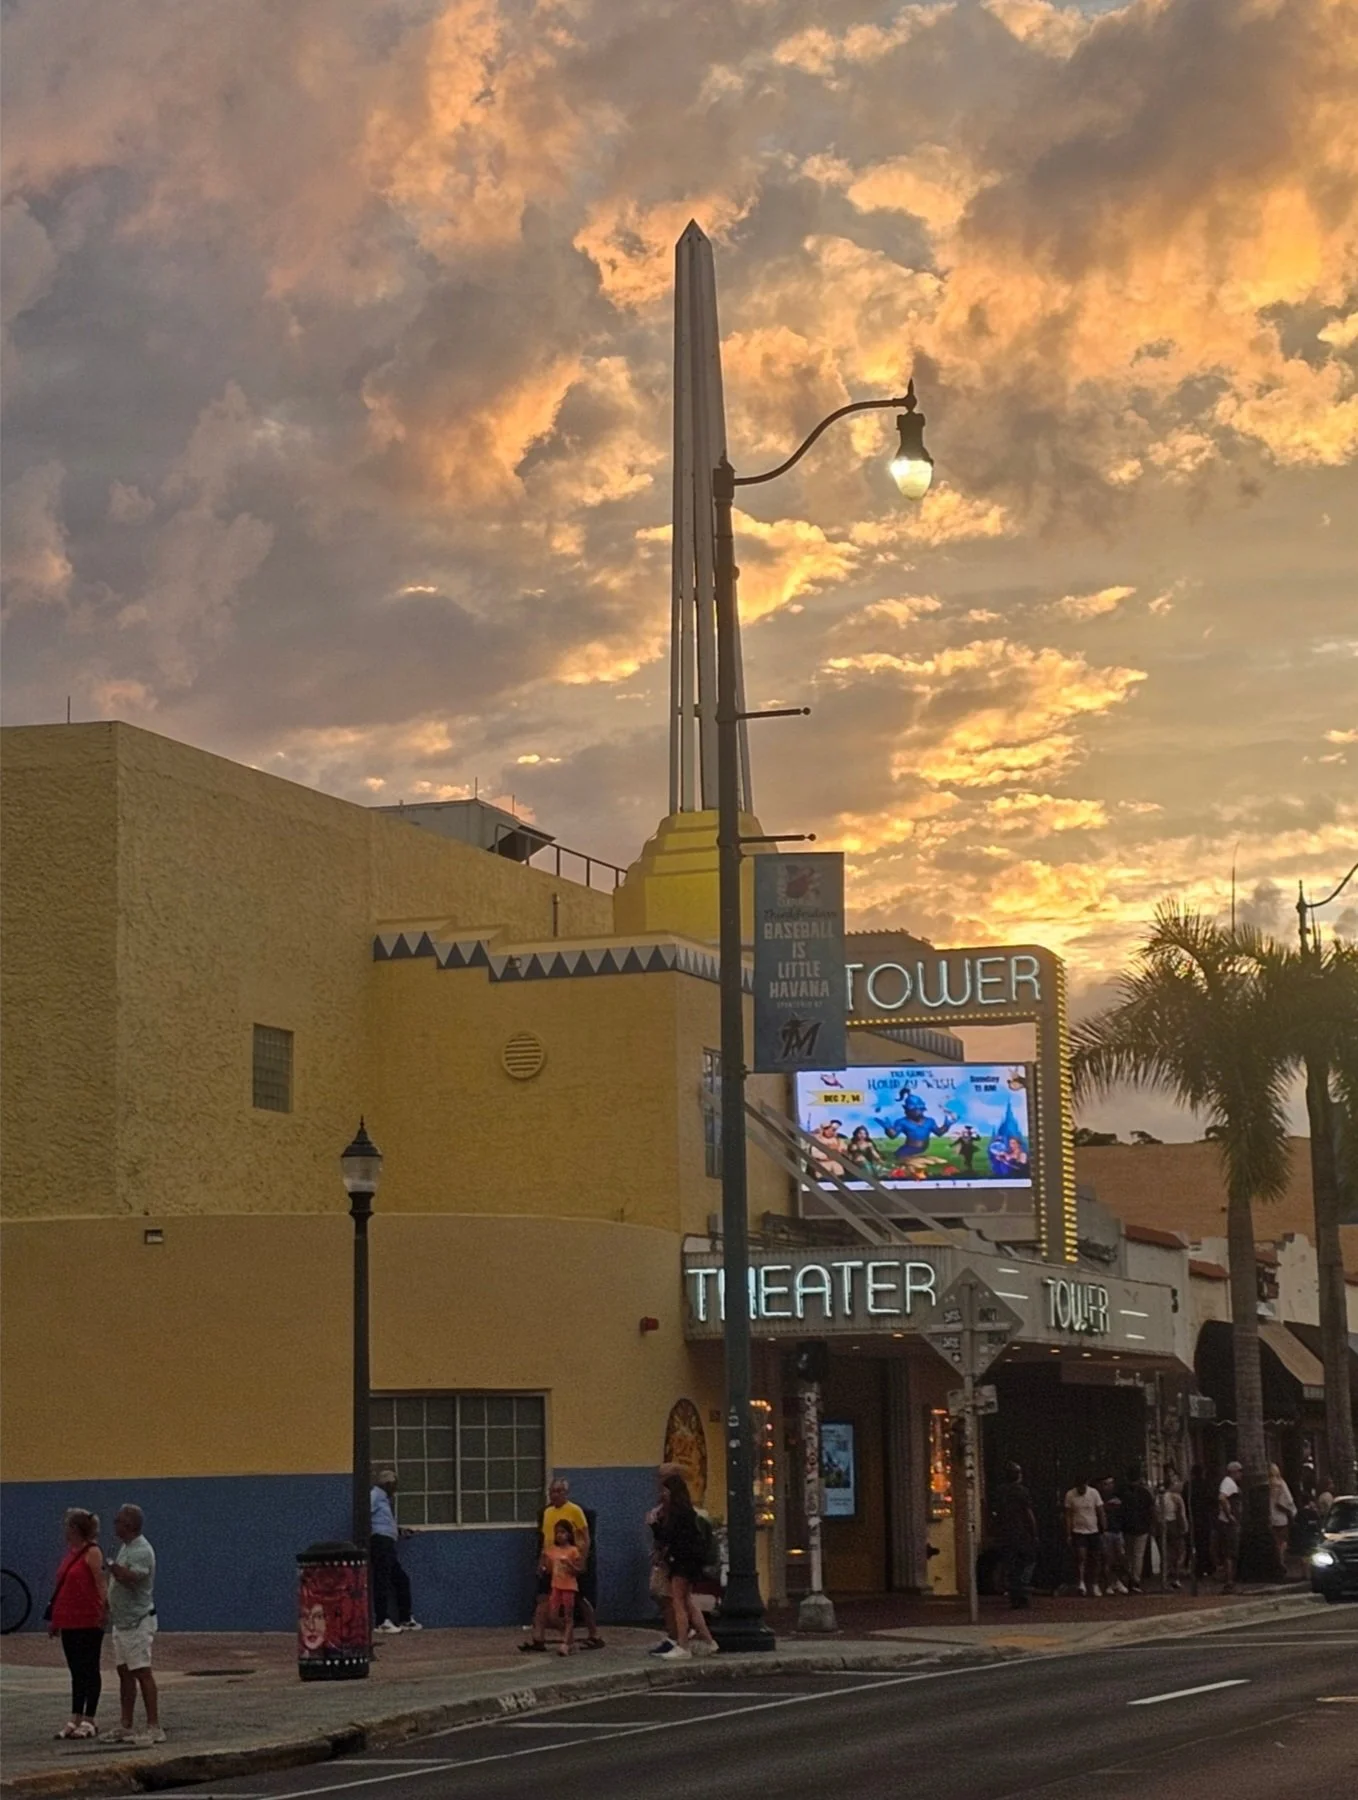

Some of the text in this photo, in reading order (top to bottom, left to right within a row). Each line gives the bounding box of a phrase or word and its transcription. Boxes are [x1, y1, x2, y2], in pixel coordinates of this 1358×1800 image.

[764, 921, 834, 939] BASEBALL
[792, 941, 806, 958] IS
[778, 960, 821, 979] LITTLE
[769, 980, 829, 997] HAVANA
[844, 955, 1041, 1011] TOWER
[823, 1094, 839, 1103] DEC
[1042, 1279, 1110, 1333] TOWER
